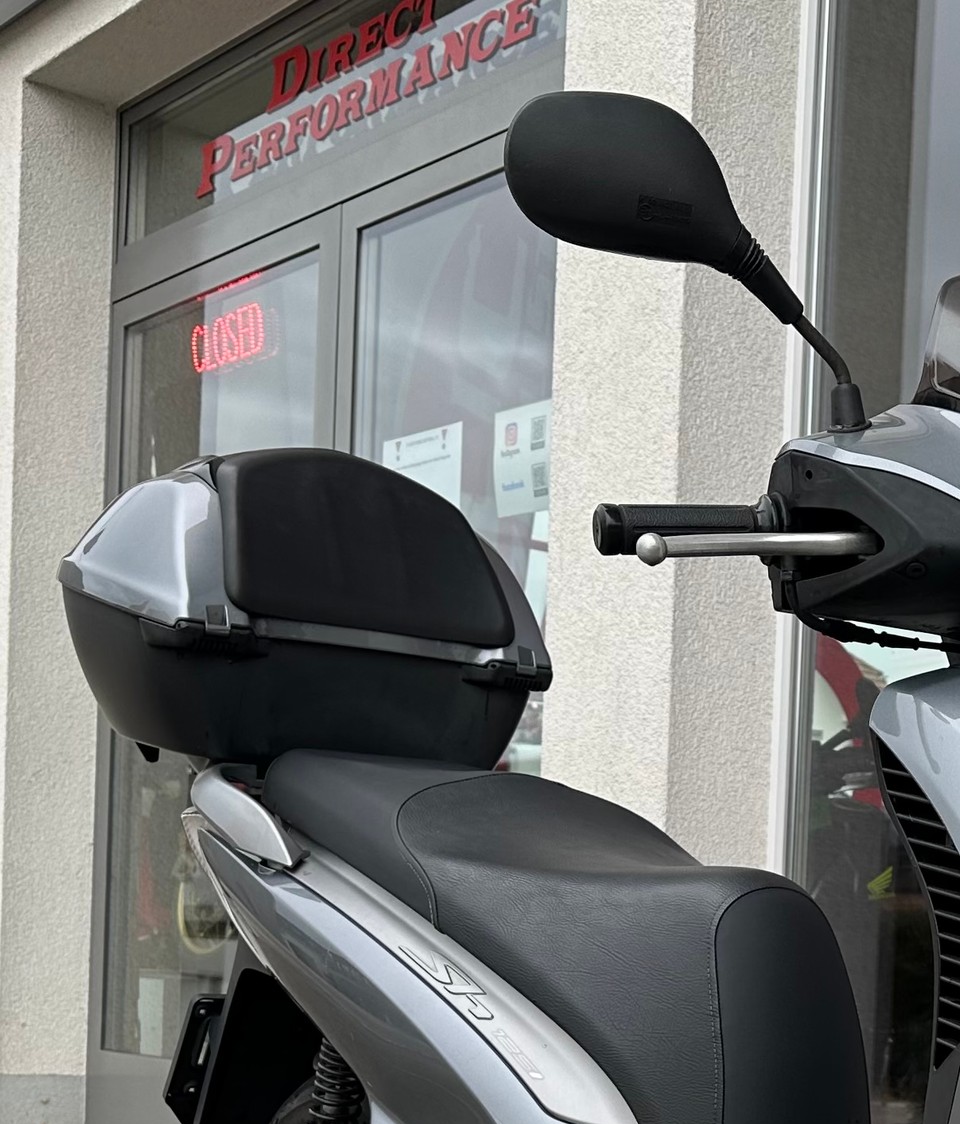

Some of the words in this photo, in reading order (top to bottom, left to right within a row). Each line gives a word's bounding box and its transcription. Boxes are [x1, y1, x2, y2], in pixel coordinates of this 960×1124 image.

[195, 0, 540, 199] PERFORMANCE
[264, 0, 438, 114] DIRECT
[191, 302, 265, 373] CLOSED
